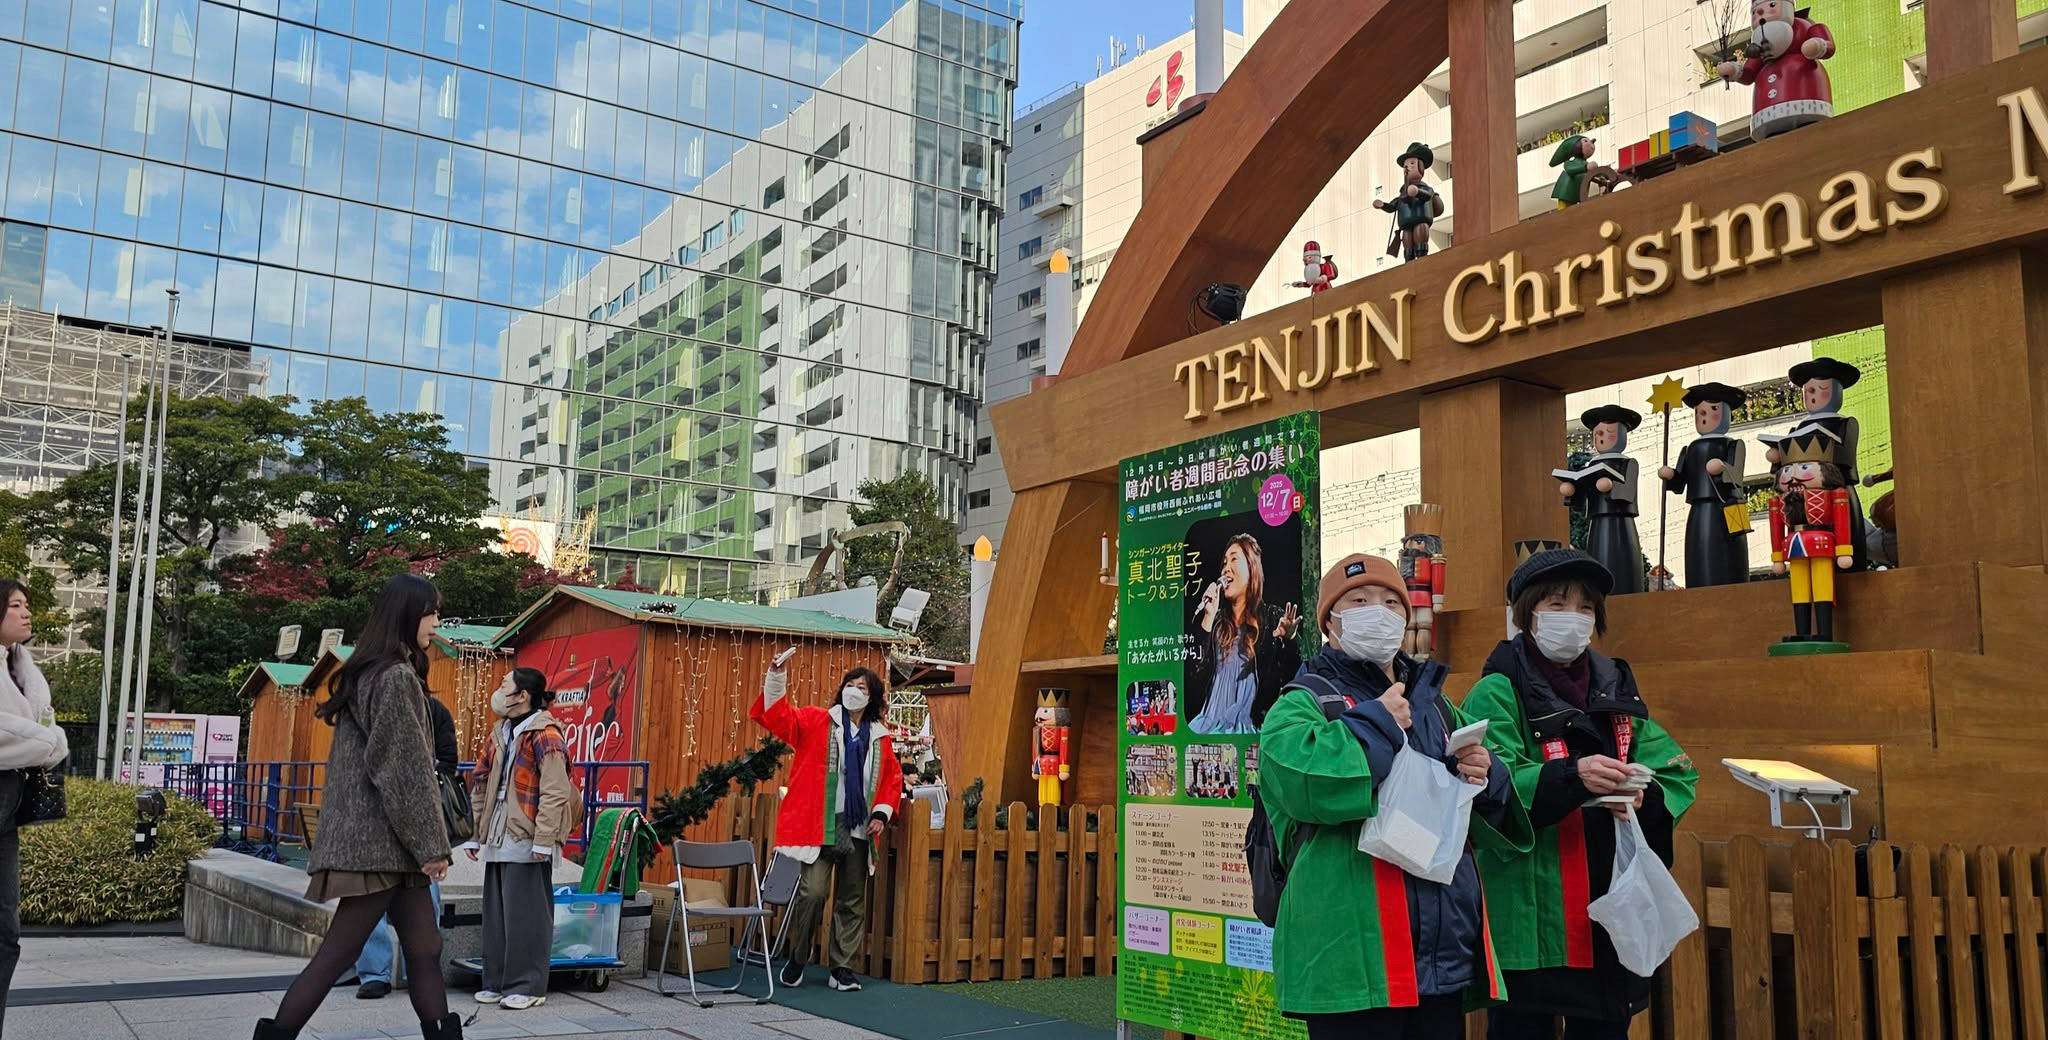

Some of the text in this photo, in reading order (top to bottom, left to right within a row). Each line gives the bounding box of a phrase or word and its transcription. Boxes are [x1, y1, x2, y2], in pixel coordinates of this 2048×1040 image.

[1174, 288, 1417, 421] TENJIN
[1443, 146, 1947, 345] Christmas
[1125, 443, 1304, 502] 障がい者週間記念の集い
[1261, 488, 1291, 511] 12/7
[1292, 496, 1301, 508] 日
[1128, 543, 1190, 559] シンガーソングライター
[1128, 552, 1202, 585] 真北聖子
[1127, 645, 1203, 665] 「あなたがいるから」
